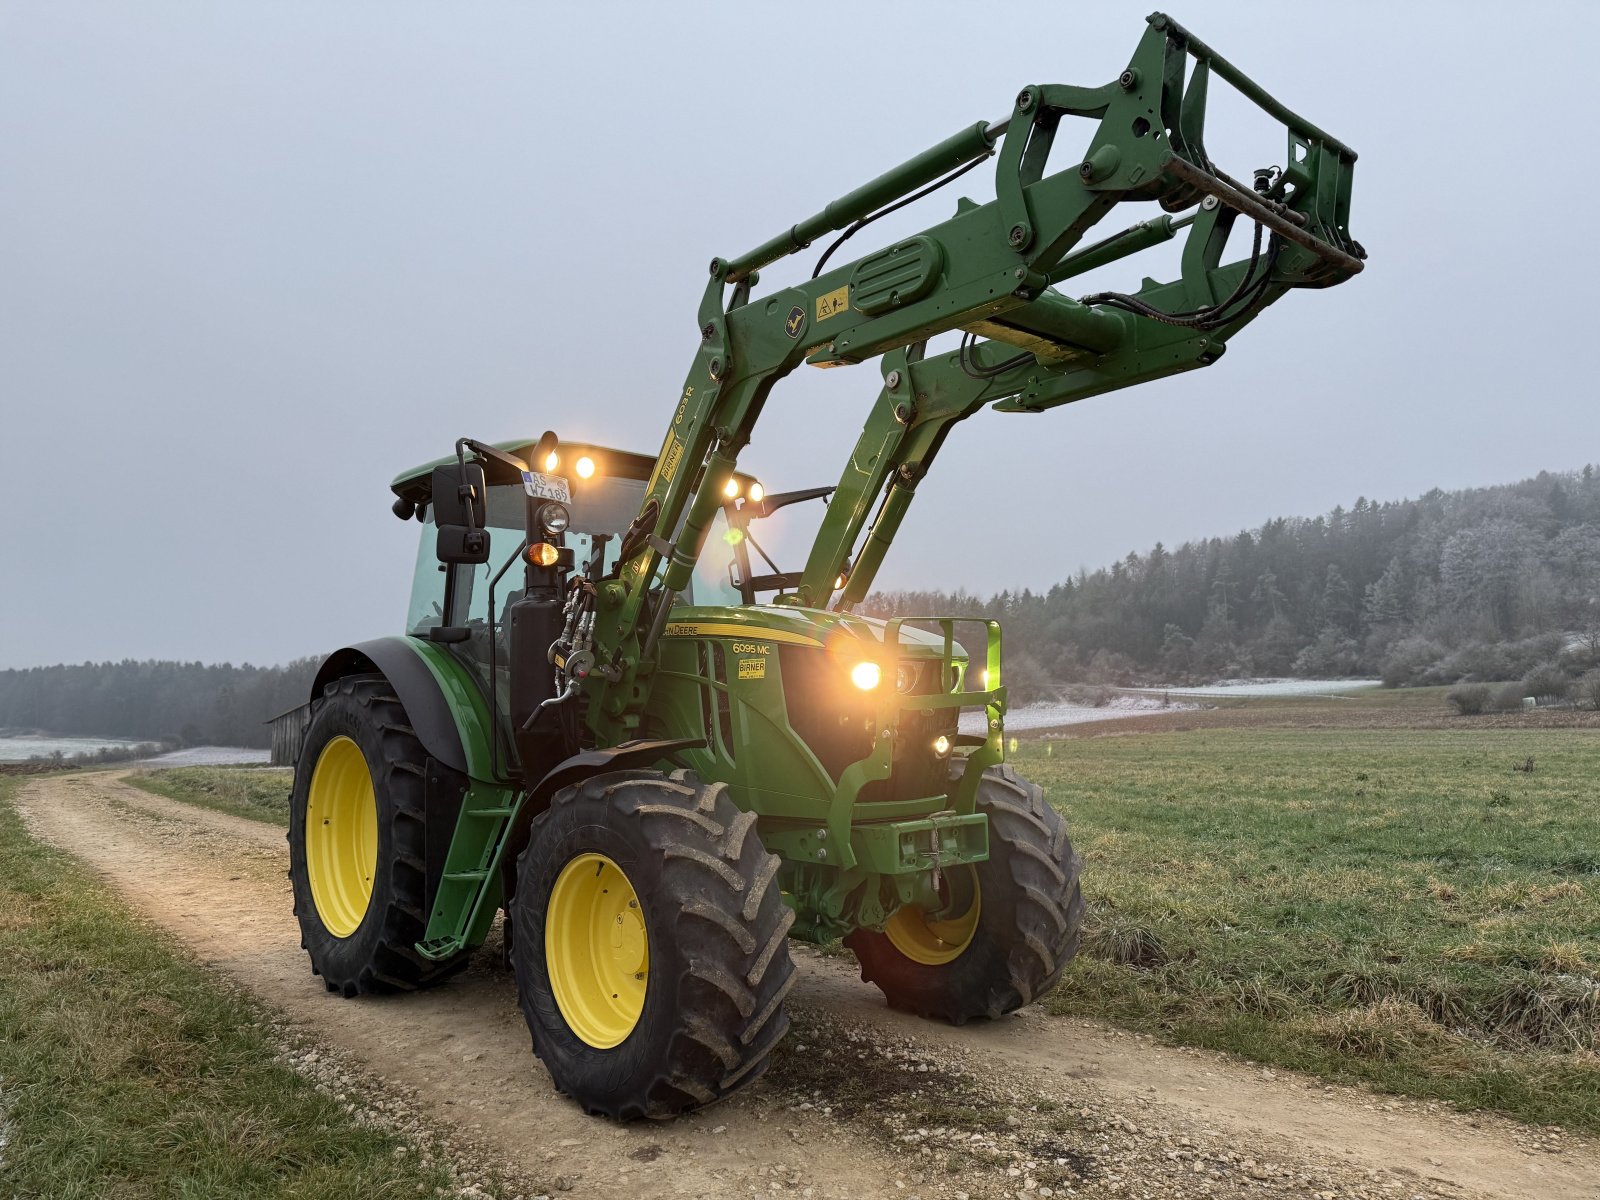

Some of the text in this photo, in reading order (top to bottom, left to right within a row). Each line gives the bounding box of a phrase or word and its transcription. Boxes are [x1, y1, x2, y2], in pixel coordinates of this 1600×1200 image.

[675, 386, 695, 425] 603 R
[664, 441, 681, 478] BIRNER
[533, 473, 547, 486] AS
[530, 483, 547, 497] WZ
[674, 625, 698, 635] DEERE
[732, 643, 771, 655] 6095 MC
[739, 663, 765, 672] BIRNER
